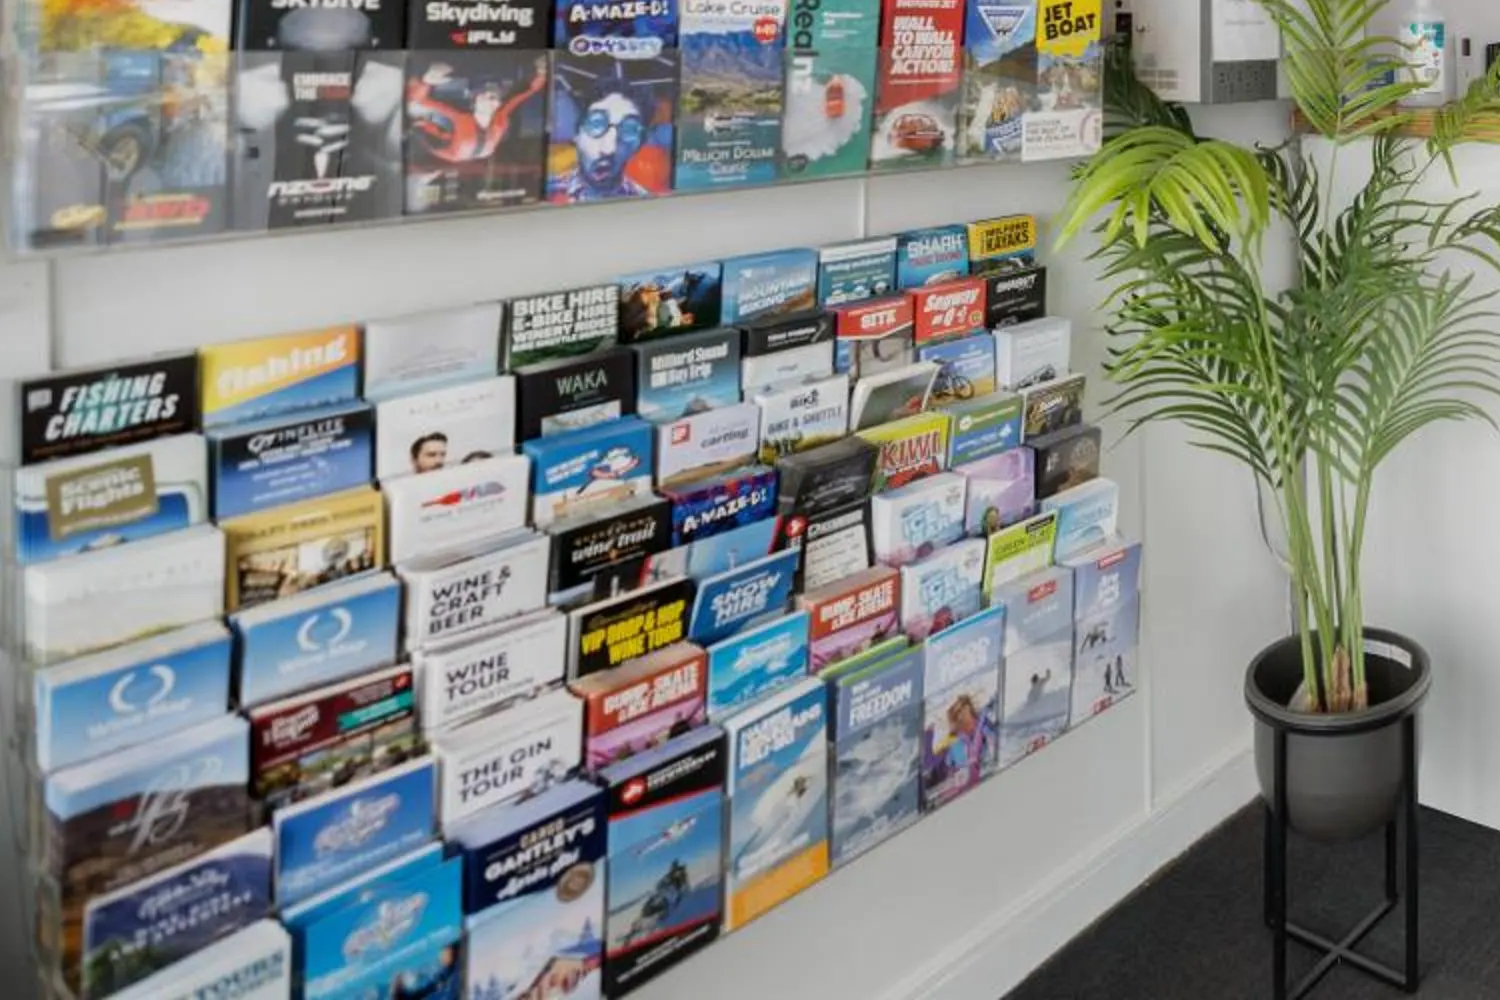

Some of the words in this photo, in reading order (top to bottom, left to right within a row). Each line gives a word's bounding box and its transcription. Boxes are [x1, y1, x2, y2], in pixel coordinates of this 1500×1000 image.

[425, 1, 534, 28] Skydiving
[685, 0, 726, 16] Lake
[728, 1, 782, 17] Cruise
[892, 15, 935, 30] WALL
[1043, 1, 1073, 24] JET
[893, 30, 914, 45] TO
[914, 30, 955, 43] WALL
[1045, 12, 1097, 41] BOAT
[891, 44, 954, 59] CANYON
[512, 292, 566, 317] BIKE
[568, 284, 619, 307] HIRE
[512, 310, 575, 332] E-BIKE
[576, 302, 618, 321] HIRE
[512, 325, 574, 344] WINERY
[216, 334, 348, 399] fishing
[555, 370, 608, 396] WAKA
[58, 371, 167, 414] FISHING
[45, 394, 180, 442] CHARTERS
[571, 535, 615, 565] wine
[616, 520, 657, 550] trail
[428, 579, 505, 617] CRAFT
[430, 571, 495, 602] WINE
[497, 564, 513, 582] &
[710, 571, 782, 612] SNOW
[427, 602, 485, 635] BEER
[444, 651, 509, 684] WINE
[446, 668, 511, 700] TOUR
[458, 755, 504, 788] THE
[509, 736, 553, 765] GIN
[458, 766, 525, 804] TOUR
[484, 816, 597, 882] GANTLEY'S
